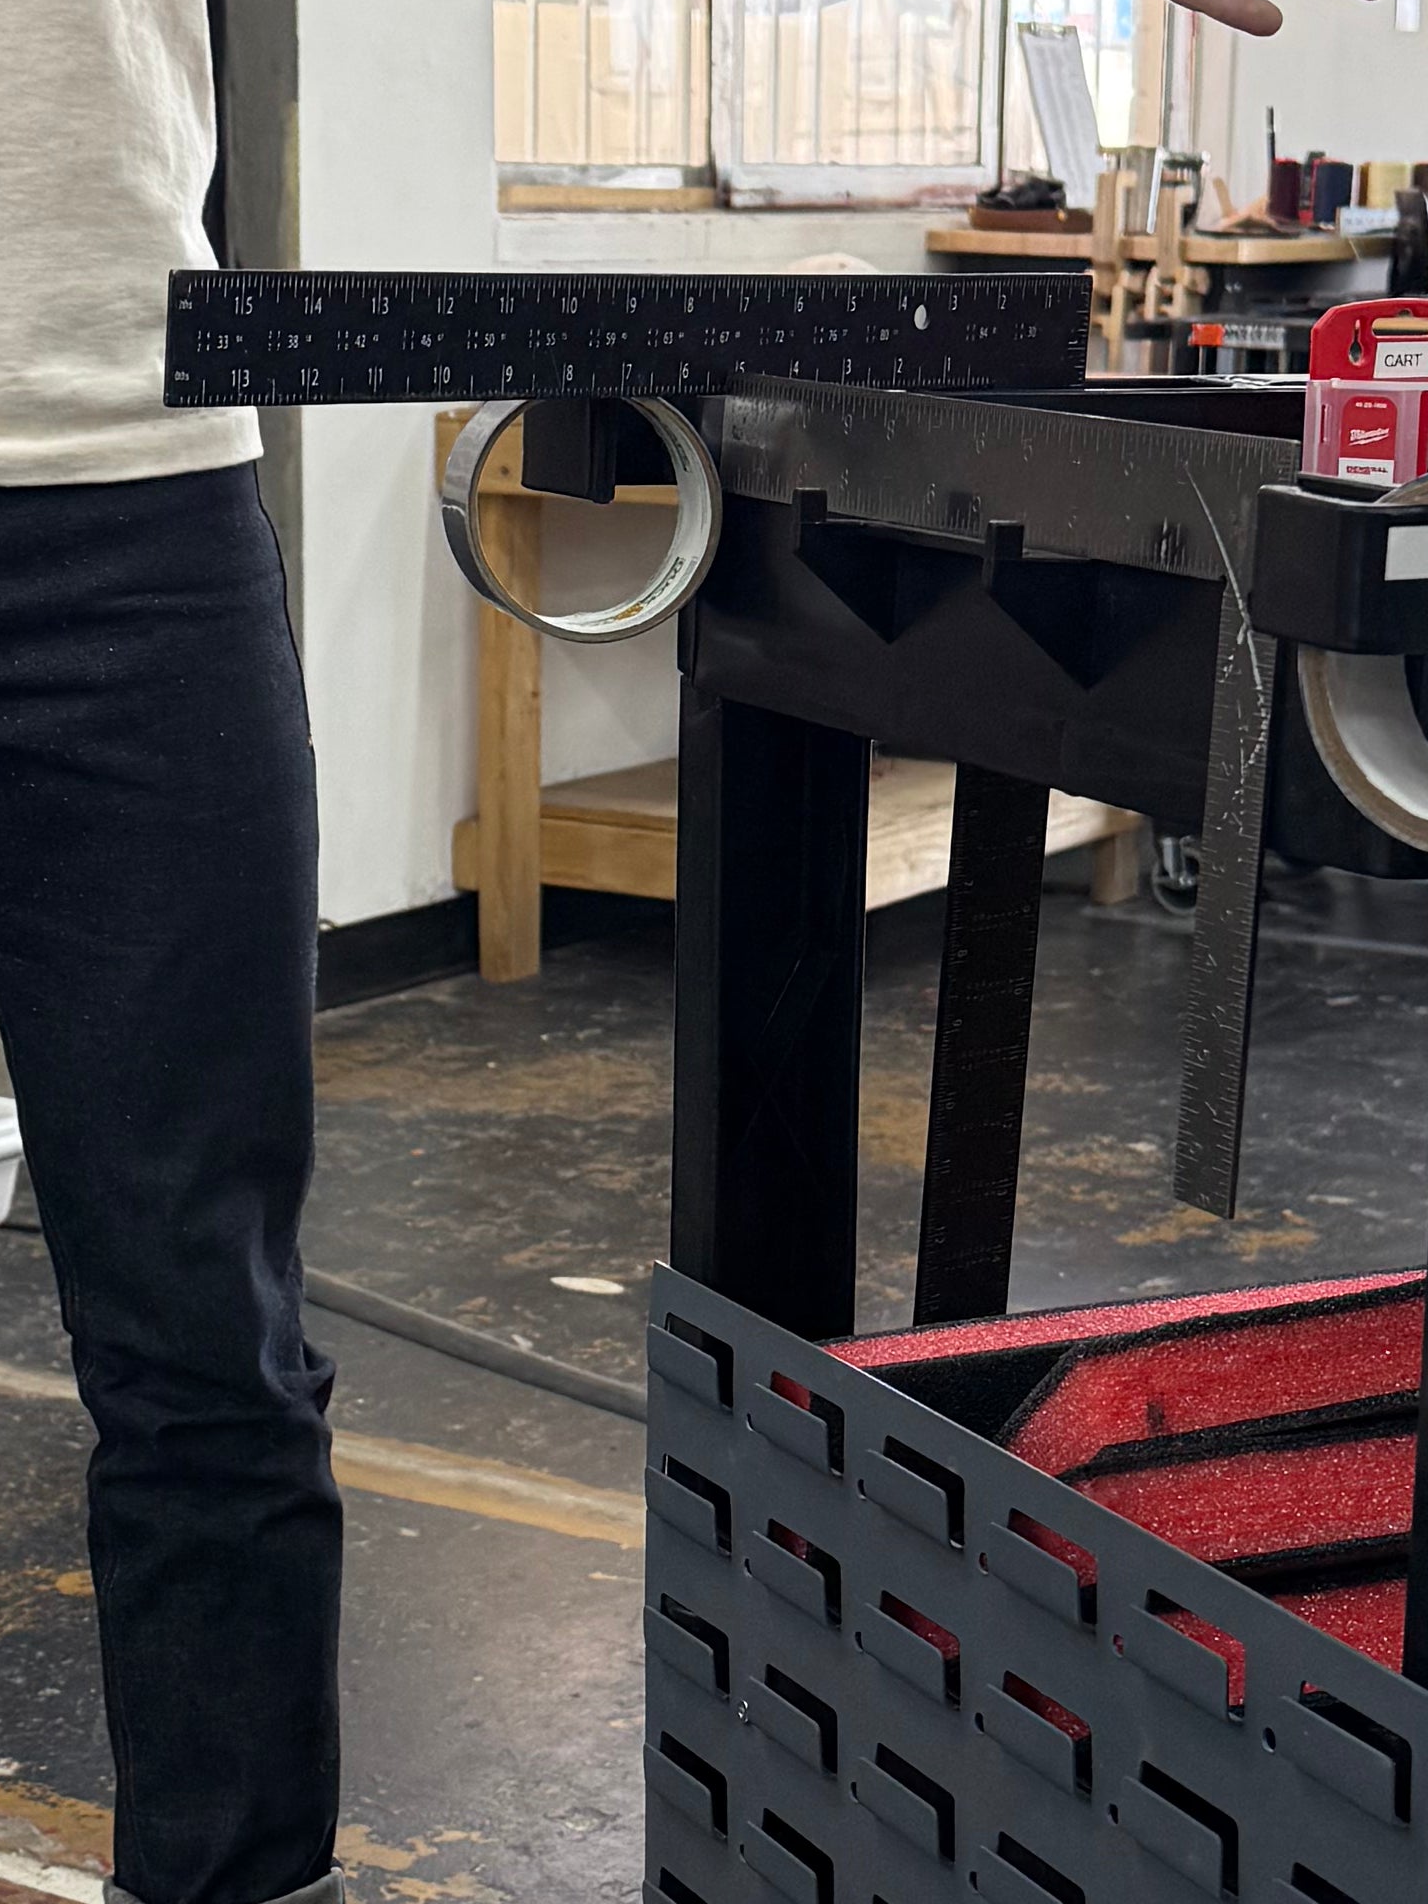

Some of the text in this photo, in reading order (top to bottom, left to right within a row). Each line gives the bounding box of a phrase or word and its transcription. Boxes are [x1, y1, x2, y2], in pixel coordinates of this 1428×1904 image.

[234, 296, 254, 315] 15
[303, 296, 323, 315] 14
[371, 296, 390, 315] 13
[437, 296, 454, 315] 12
[561, 296, 578, 314] 10
[629, 297, 638, 313] 9
[686, 297, 695, 313] 8
[742, 296, 750, 312] 7
[796, 296, 804, 312] 6
[850, 296, 857, 312] 5
[900, 295, 908, 311] 4
[951, 295, 958, 311] 3
[1000, 294, 1007, 310] 2
[1384, 350, 1424, 369] CART
[231, 369, 250, 387] 13
[300, 368, 320, 386] 12
[368, 367, 384, 386] 11
[432, 366, 451, 384] 10
[505, 365, 514, 382] 9
[565, 364, 574, 381] 8
[624, 364, 633, 380] 7
[681, 363, 690, 379] 6
[792, 360, 800, 376] 4
[845, 358, 852, 375] 3
[896, 358, 904, 373] 2
